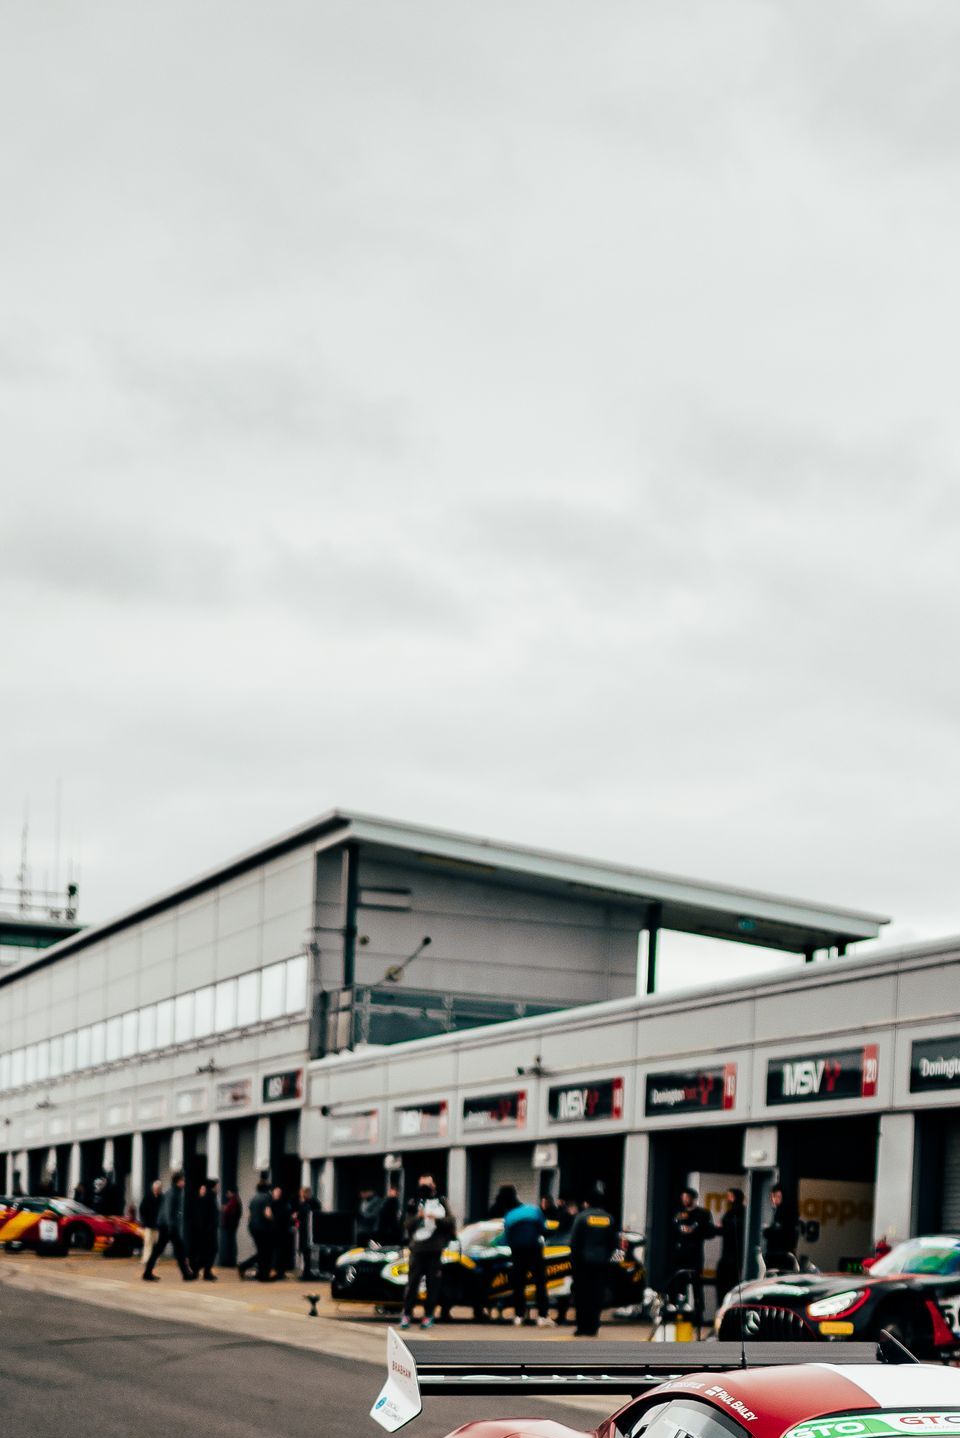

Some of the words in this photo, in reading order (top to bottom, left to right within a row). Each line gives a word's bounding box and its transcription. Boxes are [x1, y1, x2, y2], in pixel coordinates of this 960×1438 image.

[783, 1059, 826, 1096] MSV
[715, 1390, 735, 1405] PAUL
[730, 1400, 758, 1421] BAILEY
